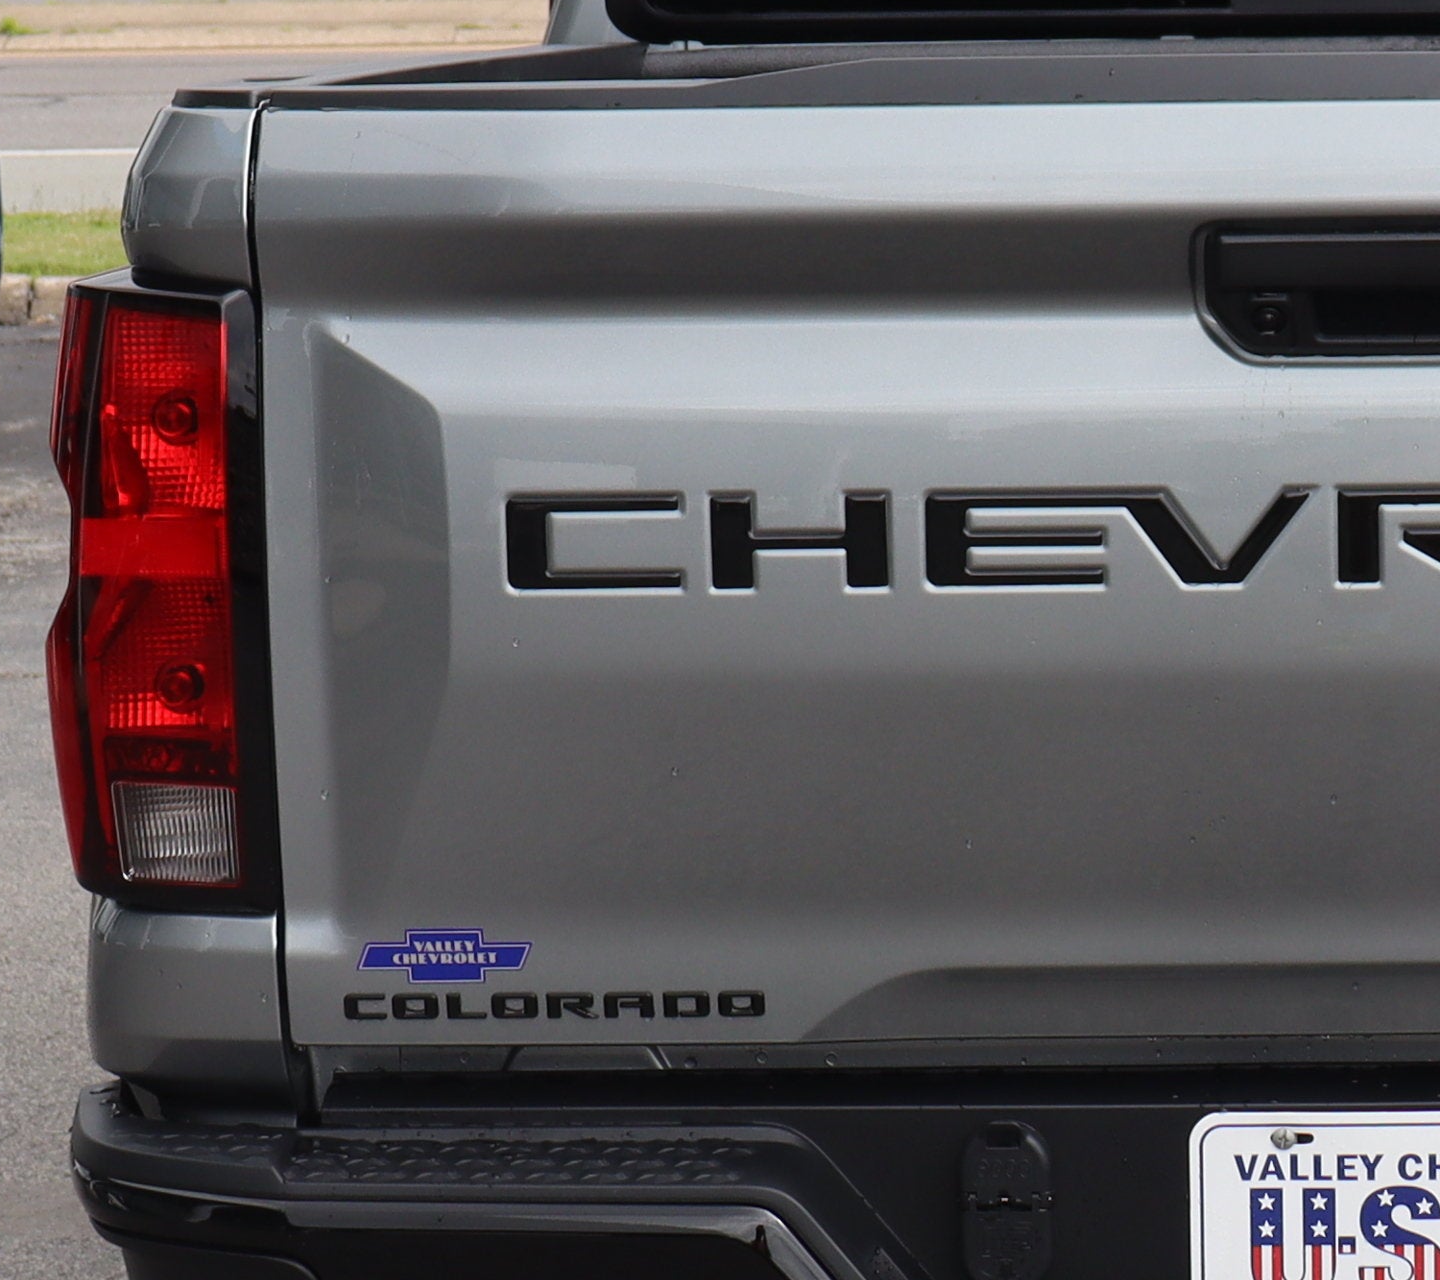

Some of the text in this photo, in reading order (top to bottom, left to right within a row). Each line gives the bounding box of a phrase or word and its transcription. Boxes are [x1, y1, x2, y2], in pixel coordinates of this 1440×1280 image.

[413, 939, 477, 953] VALLEY
[392, 951, 498, 966] CHEVROLET
[343, 989, 766, 1021] COLORADO
[1234, 1153, 1384, 1182] VALLEY
